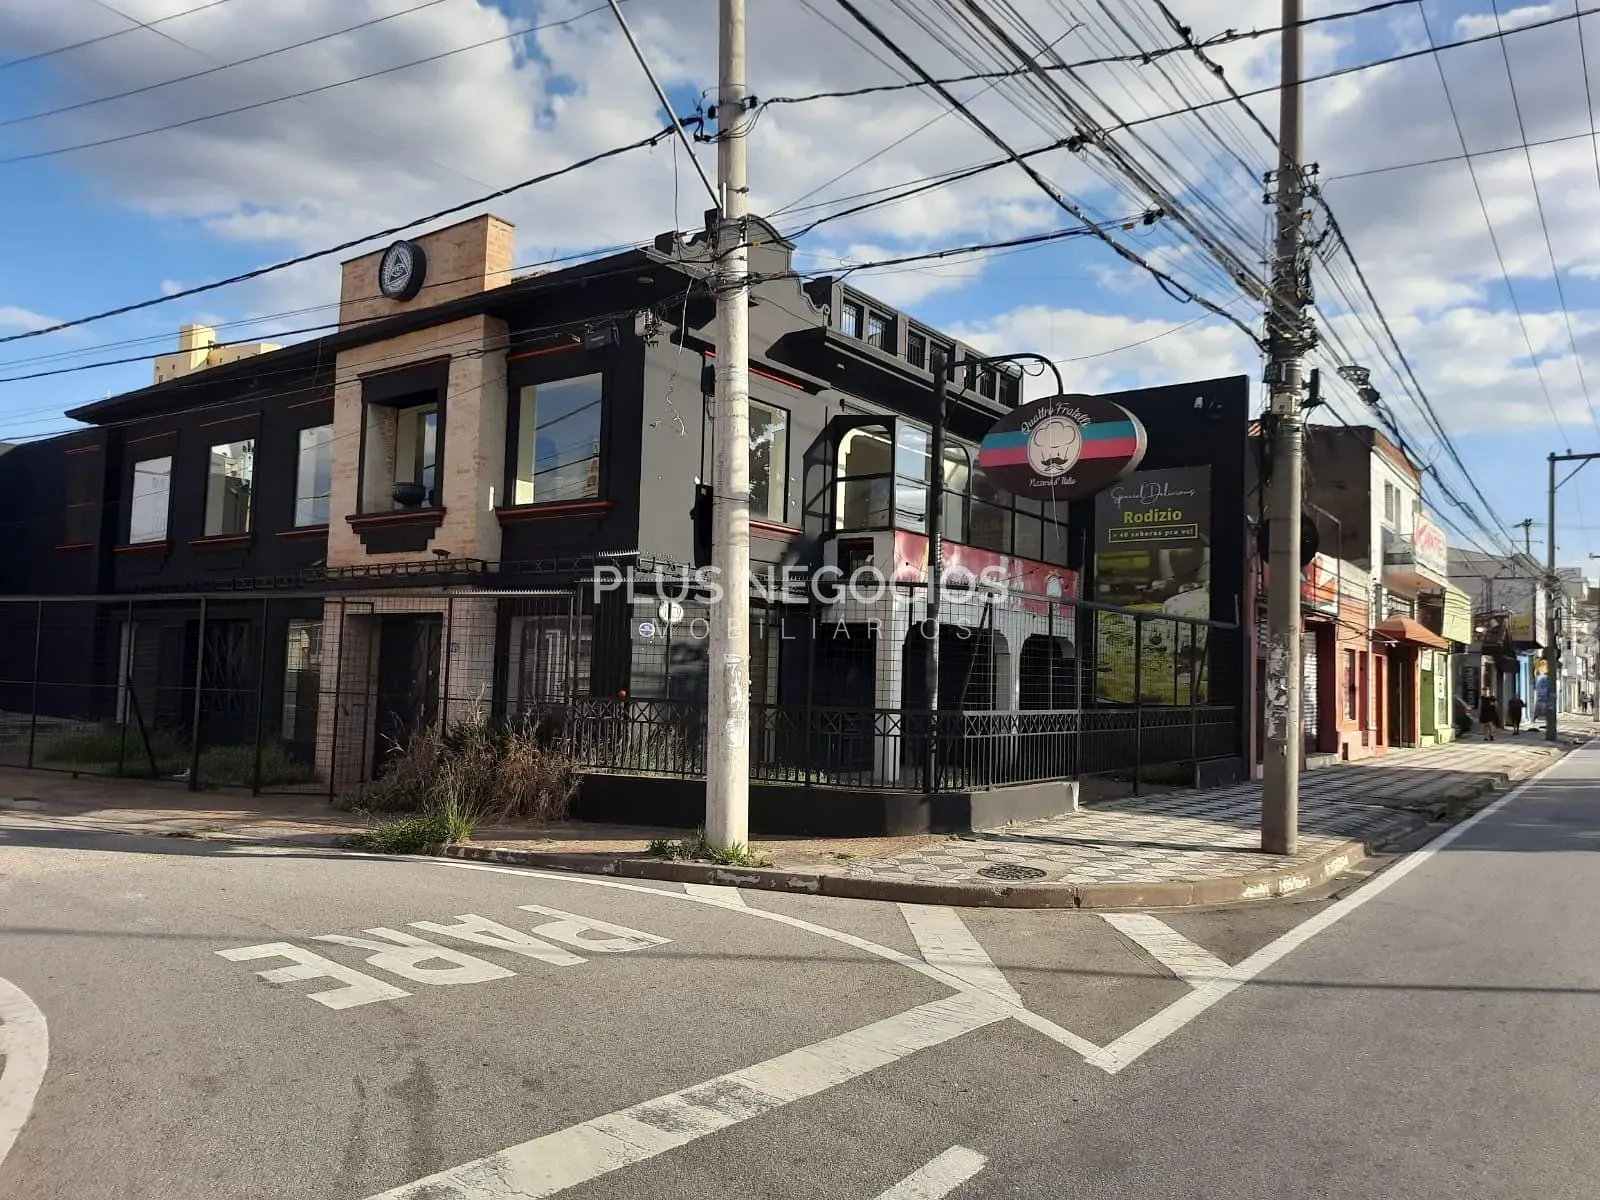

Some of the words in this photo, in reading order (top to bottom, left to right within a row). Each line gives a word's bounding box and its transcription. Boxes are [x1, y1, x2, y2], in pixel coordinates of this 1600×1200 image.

[1056, 401, 1091, 428] Fratelli
[1123, 507, 1183, 524] Rodizio
[214, 904, 674, 1010] PARE
